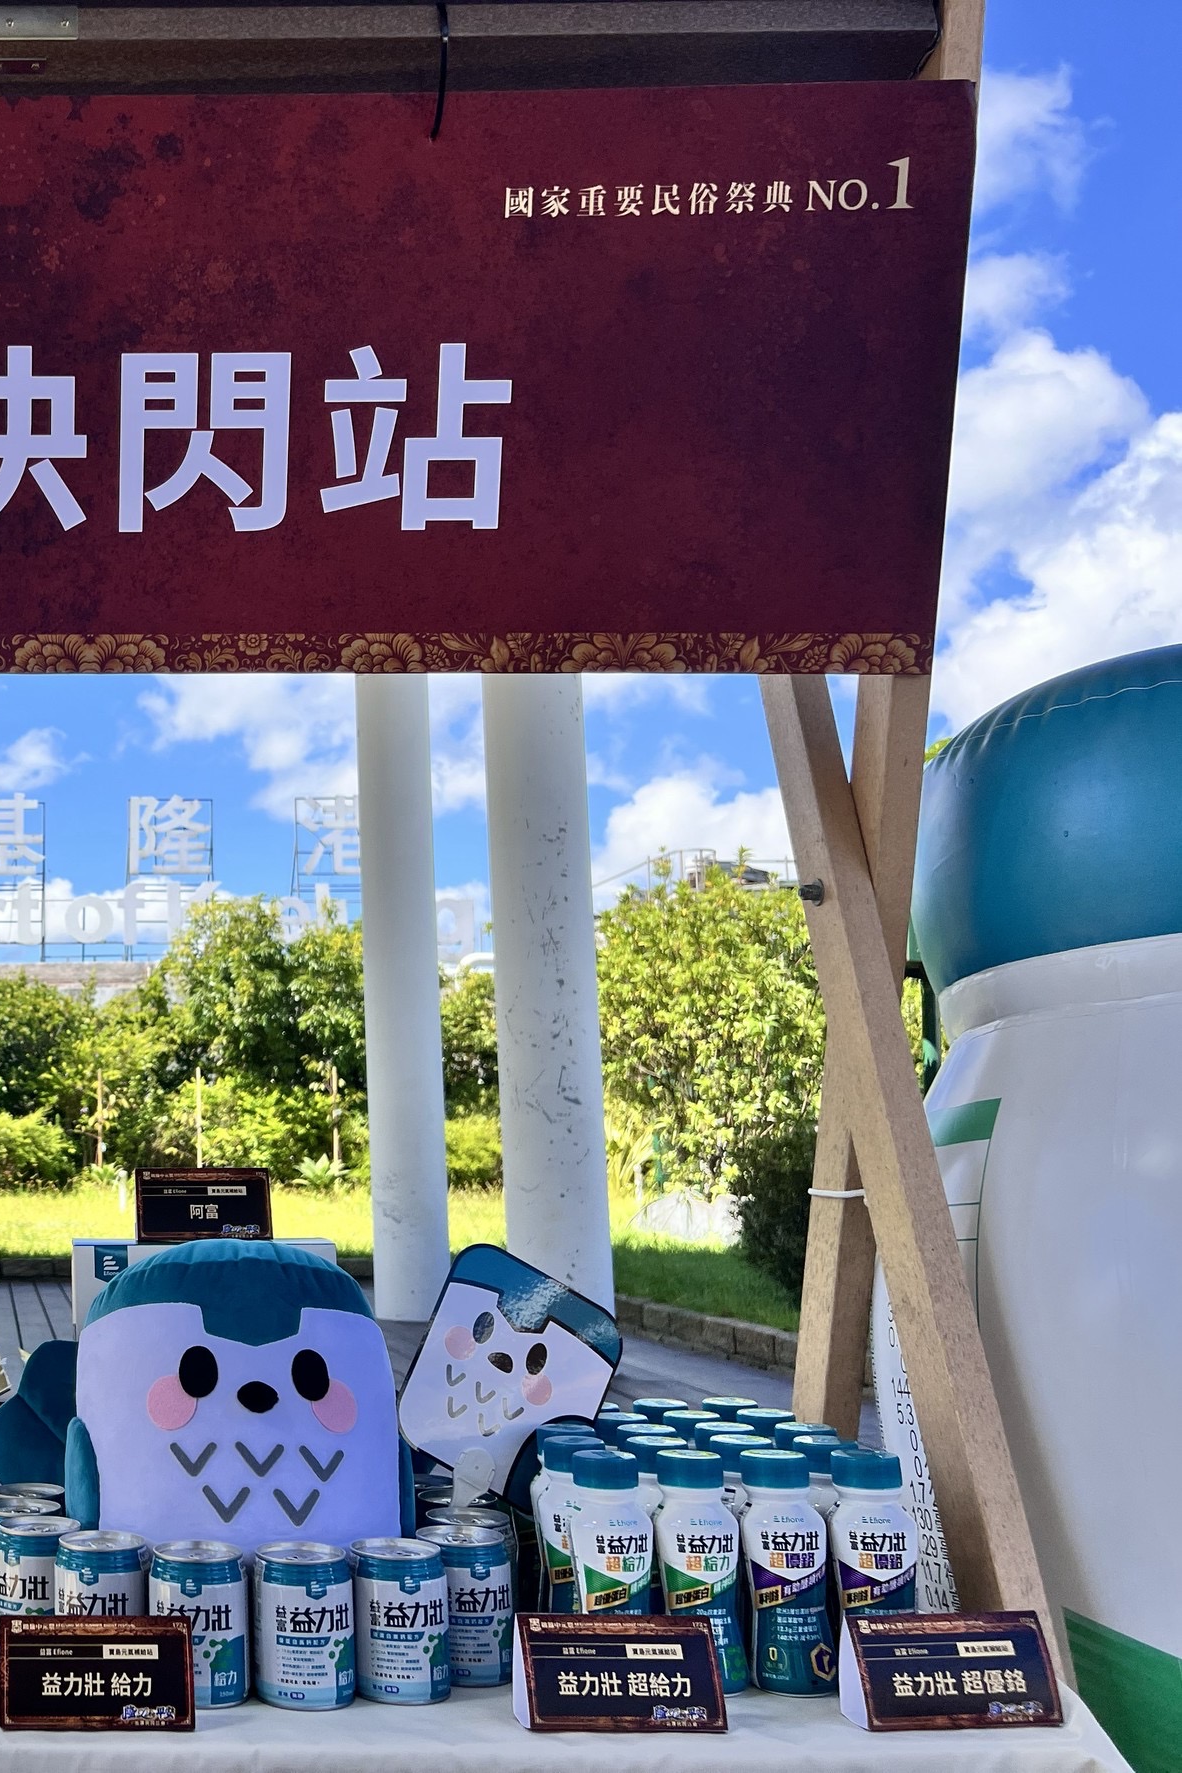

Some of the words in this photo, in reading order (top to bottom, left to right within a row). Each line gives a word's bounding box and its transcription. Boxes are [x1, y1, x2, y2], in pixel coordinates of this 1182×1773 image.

[504, 180, 794, 219] 國家重要民俗祭典
[65, 882, 149, 945] of
[190, 1204, 218, 1219] 阿富
[897, 1403, 915, 1425] 5.3
[910, 1429, 918, 1451] 0
[914, 1456, 923, 1478] 0
[607, 1533, 648, 1555] 益力壯
[688, 1533, 734, 1554] 益力壯
[771, 1531, 820, 1552] 益力壯
[859, 1531, 908, 1552] 益力壯
[605, 1556, 645, 1572] 超給力
[686, 1555, 730, 1572] 超給力
[769, 1552, 815, 1569] 超優鉻
[859, 1552, 903, 1570] 超優鉻
[455, 1583, 510, 1613] 益力壯
[925, 1584, 950, 1613] 0.14
[276, 1605, 287, 1632] 益富
[290, 1603, 350, 1633] 益力壯
[383, 1598, 445, 1628] 益力壯
[41, 1672, 105, 1697] 益力壯
[110, 1672, 152, 1697] 給力
[213, 1670, 237, 1687] 給力
[557, 1671, 623, 1697] 益力壯
[628, 1672, 692, 1698] 超給力
[892, 1670, 958, 1697] 益力壯
[961, 1668, 1027, 1695] 超優鉻
